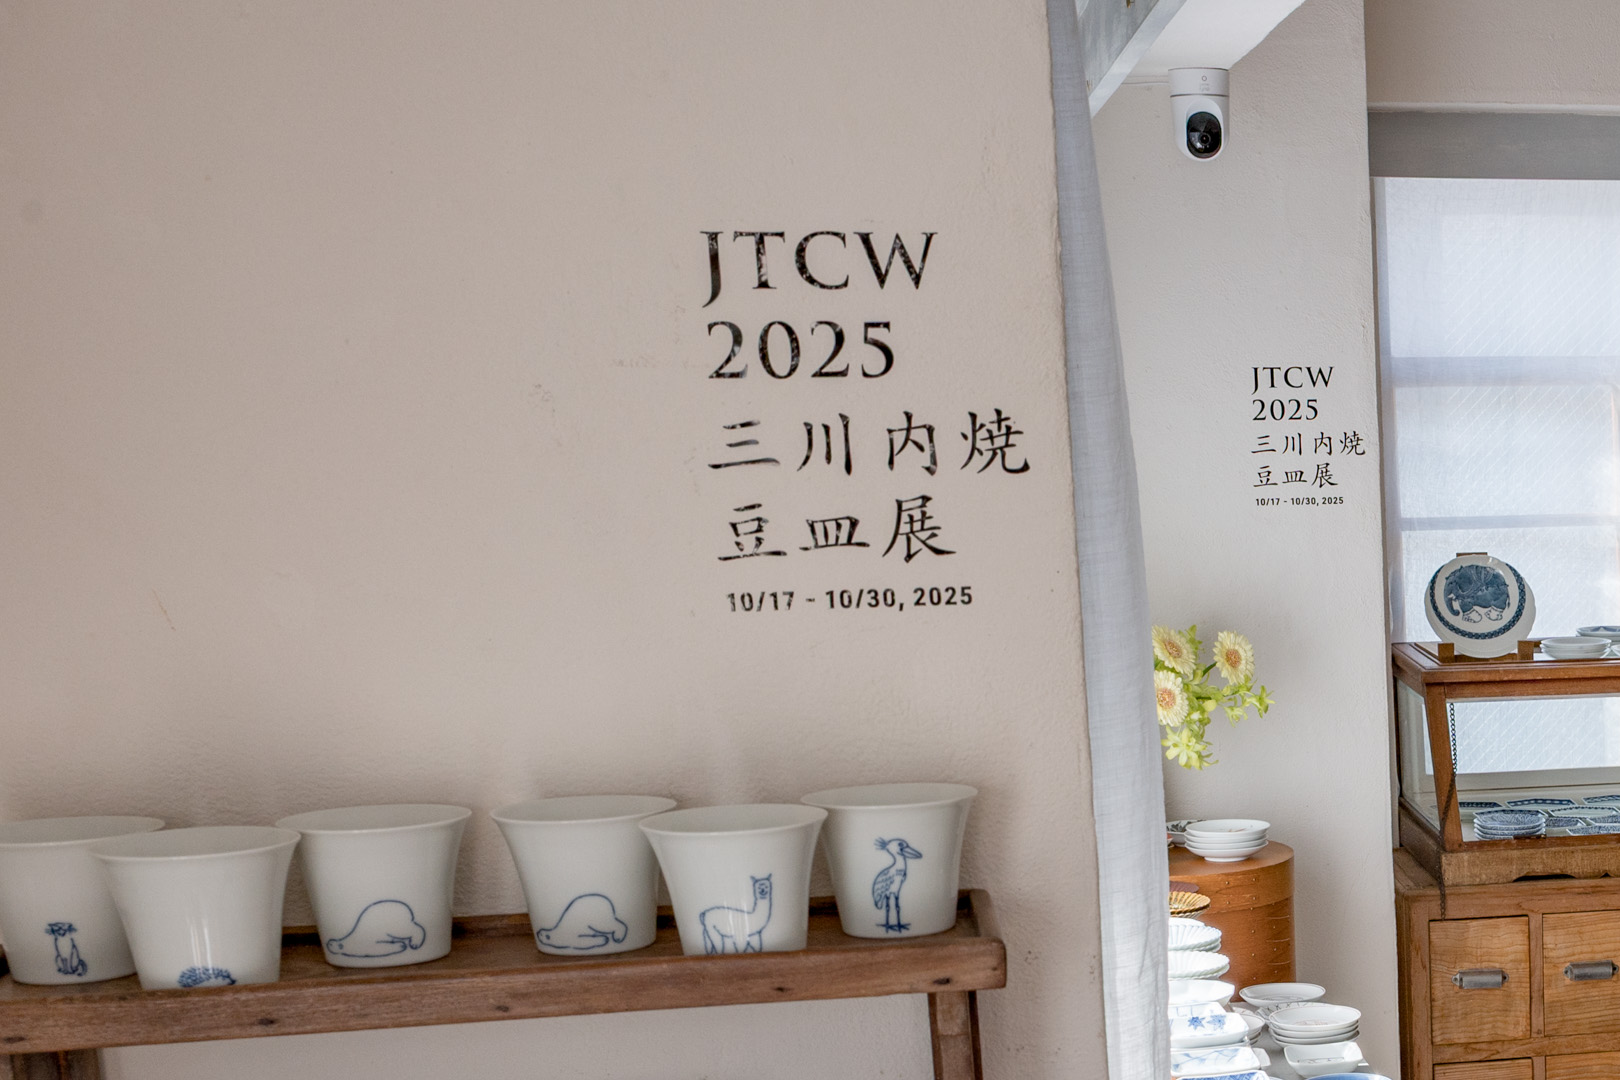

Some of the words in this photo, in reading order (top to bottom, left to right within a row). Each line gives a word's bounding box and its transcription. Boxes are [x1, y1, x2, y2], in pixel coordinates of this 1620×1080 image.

[700, 230, 938, 308] JTCW
[707, 320, 895, 380] 2025
[1252, 366, 1334, 395] JTCW
[1252, 398, 1318, 421] 2025
[708, 407, 1031, 477] 三川内焼
[1251, 430, 1366, 456] 三川内焼
[1253, 462, 1338, 489] 豆皿展
[1255, 497, 1280, 506] 10/17
[1290, 496, 1319, 507] 10/30,
[1321, 496, 1344, 505] 2025
[717, 494, 957, 564] 豆皿展
[727, 591, 795, 612] 10/17
[825, 588, 904, 612] 10/30,
[913, 585, 973, 607] 2025
